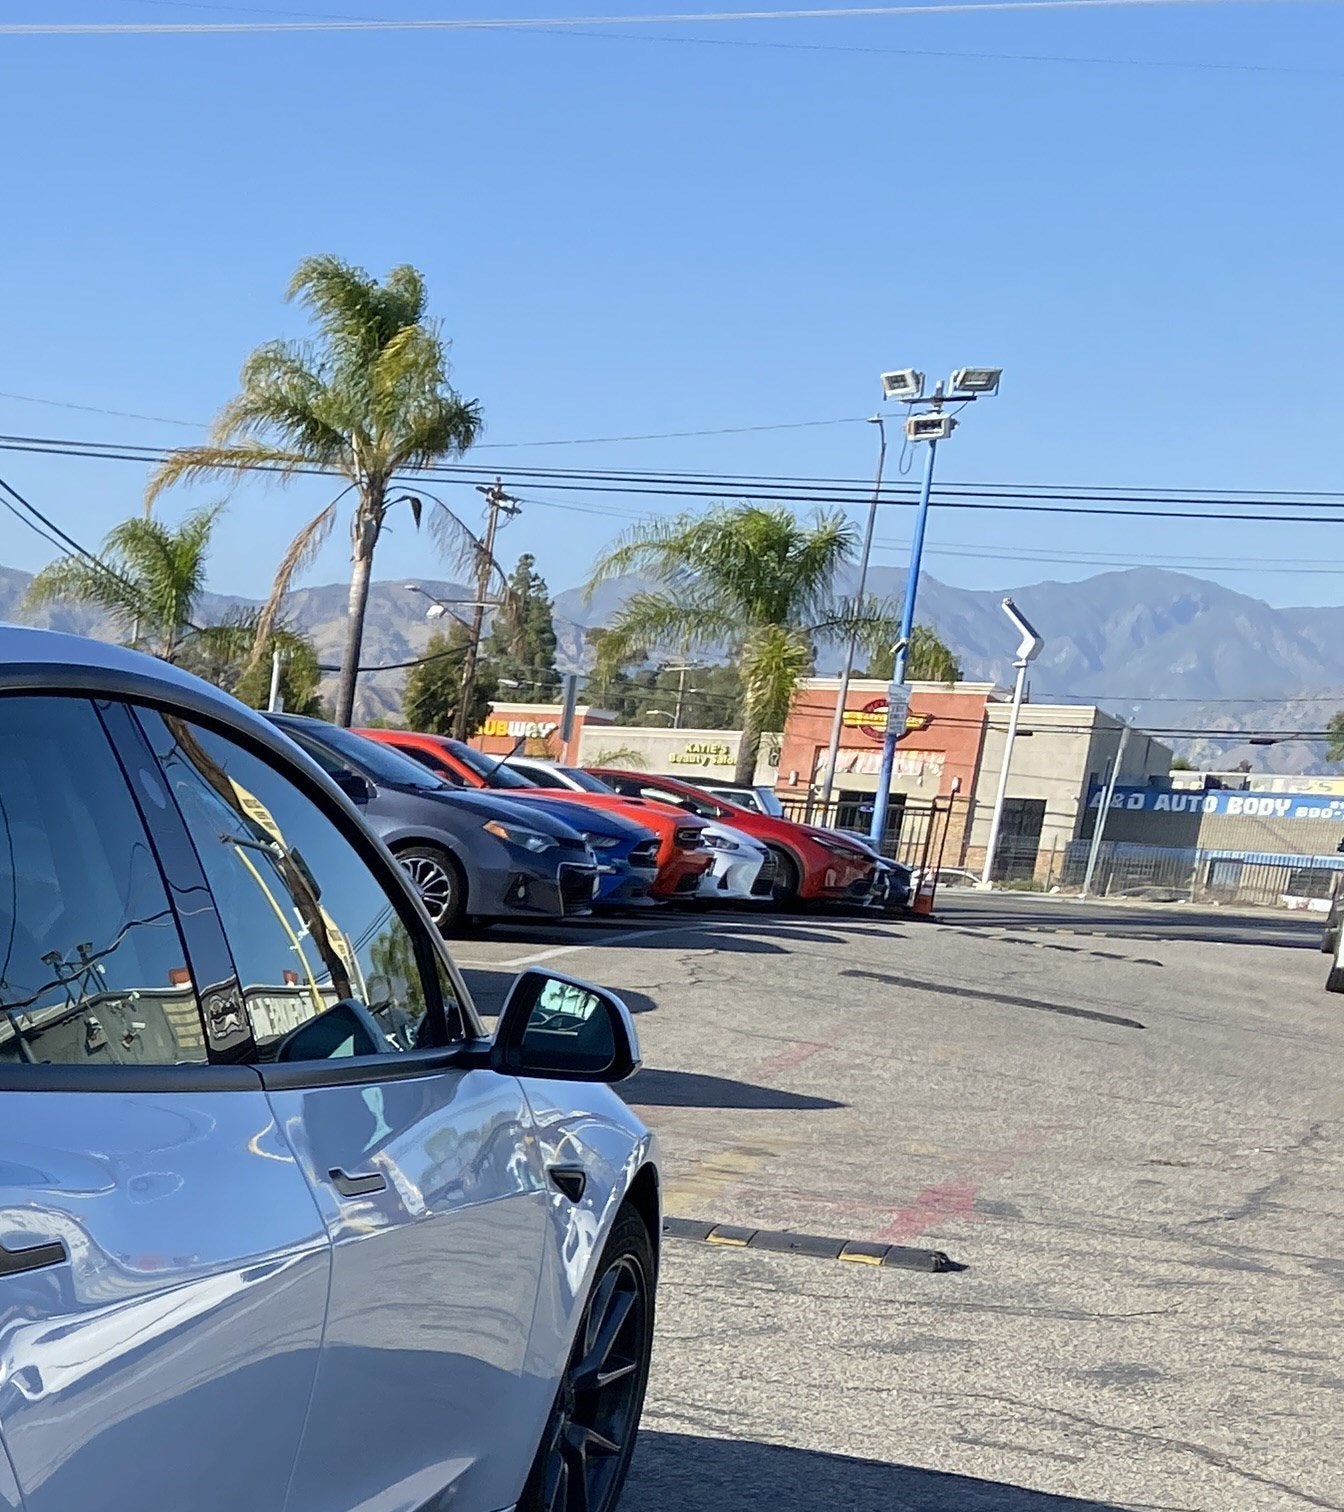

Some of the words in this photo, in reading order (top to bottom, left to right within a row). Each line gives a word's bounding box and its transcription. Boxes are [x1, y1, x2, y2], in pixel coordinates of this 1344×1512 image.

[685, 743, 729, 755] KATIE'S
[668, 752, 710, 767] Beauty
[1153, 794, 1218, 813] AUTO
[1226, 797, 1292, 817] BODY
